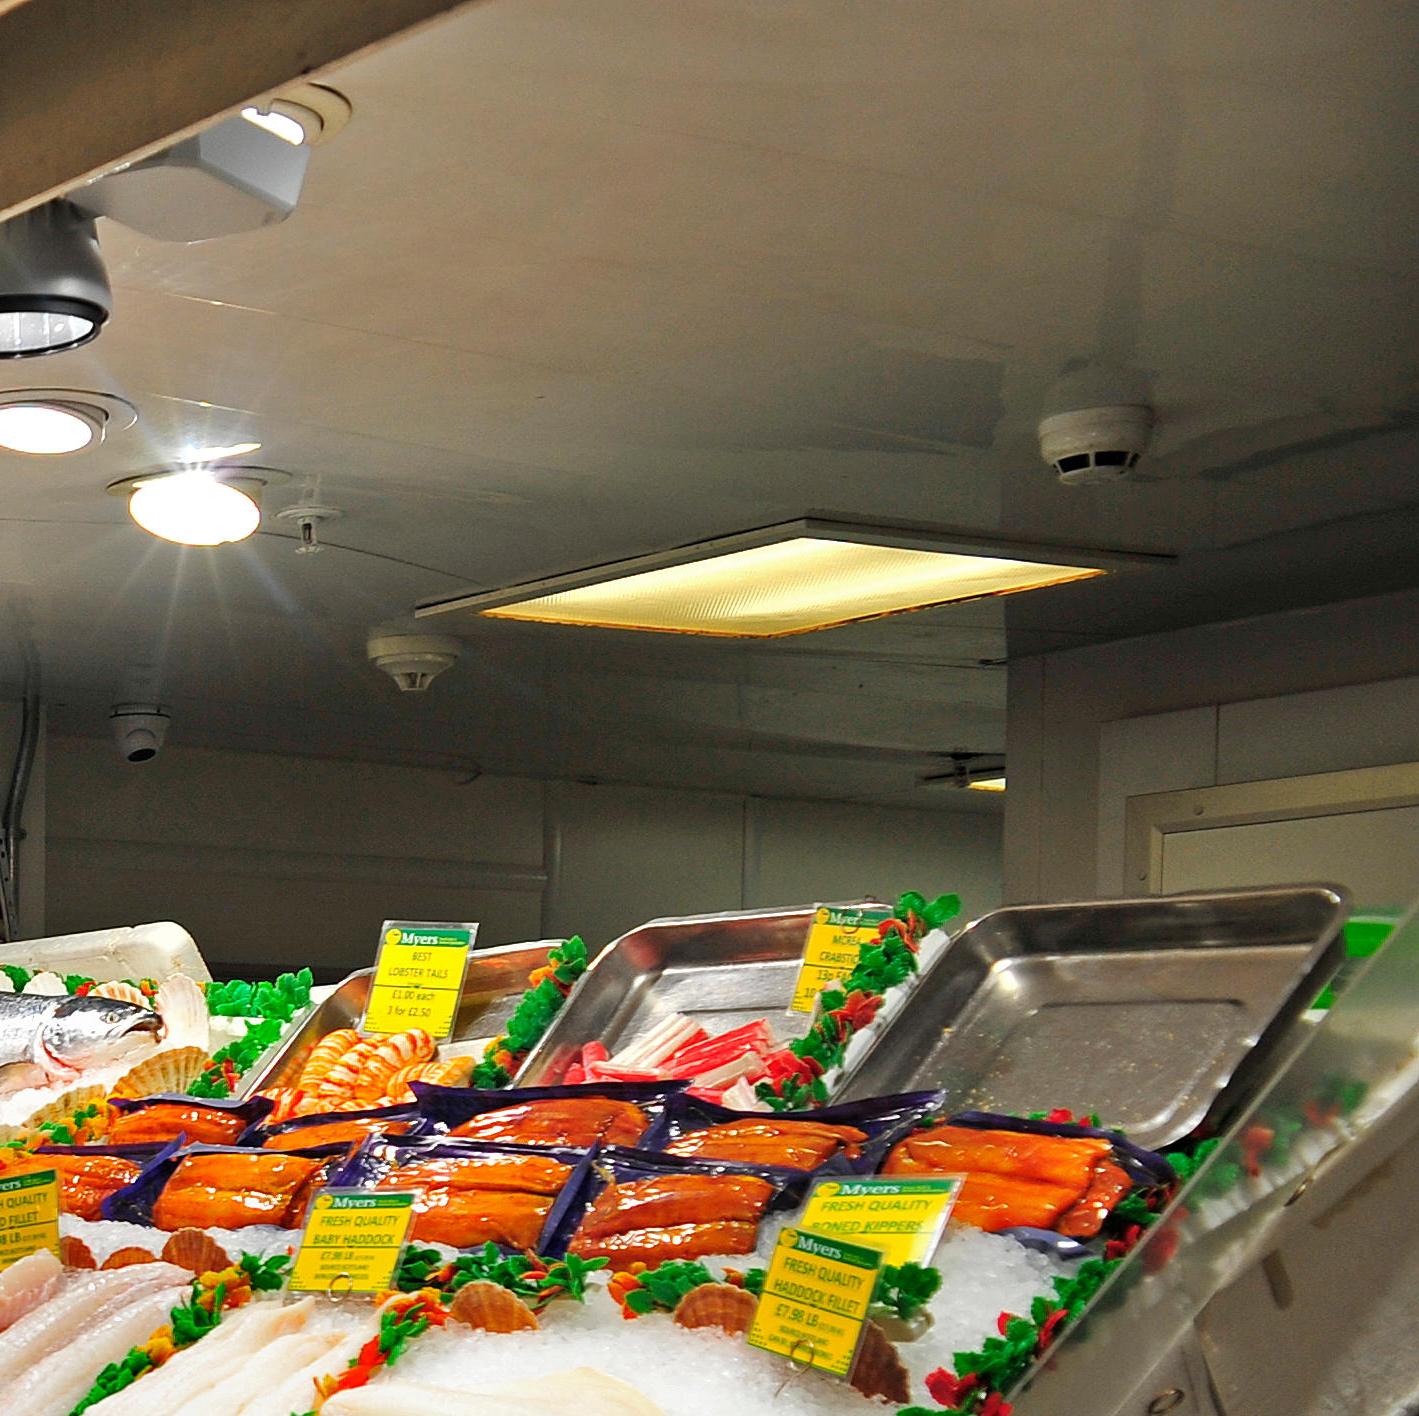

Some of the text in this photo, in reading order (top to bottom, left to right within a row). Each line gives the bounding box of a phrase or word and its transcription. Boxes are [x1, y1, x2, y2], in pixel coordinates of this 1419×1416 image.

[401, 932, 439, 946] Myers
[411, 951, 433, 961] BEST
[388, 967, 449, 979] LOBSTER TAILS
[392, 989, 436, 1001] £1.00 each
[395, 1005, 406, 1016] for
[407, 1007, 432, 1017] £2.50
[840, 1184, 901, 1196] Myers
[6, 1192, 48, 1209] QUALITY
[332, 1197, 377, 1209] Myers
[821, 1199, 933, 1213] FRESH QUALITY
[9, 1211, 39, 1225] FILLET
[320, 1215, 400, 1227] FRESH QUALITY
[813, 1220, 924, 1233] BONED KIPPERS
[10, 1232, 22, 1243] LB
[313, 1233, 396, 1245] BABY HADDOCK
[797, 1235, 842, 1260] Myers
[784, 1257, 866, 1291] FRESH QUALITY
[773, 1279, 861, 1315] HADDOCK FILLET
[806, 1310, 820, 1328] LB
